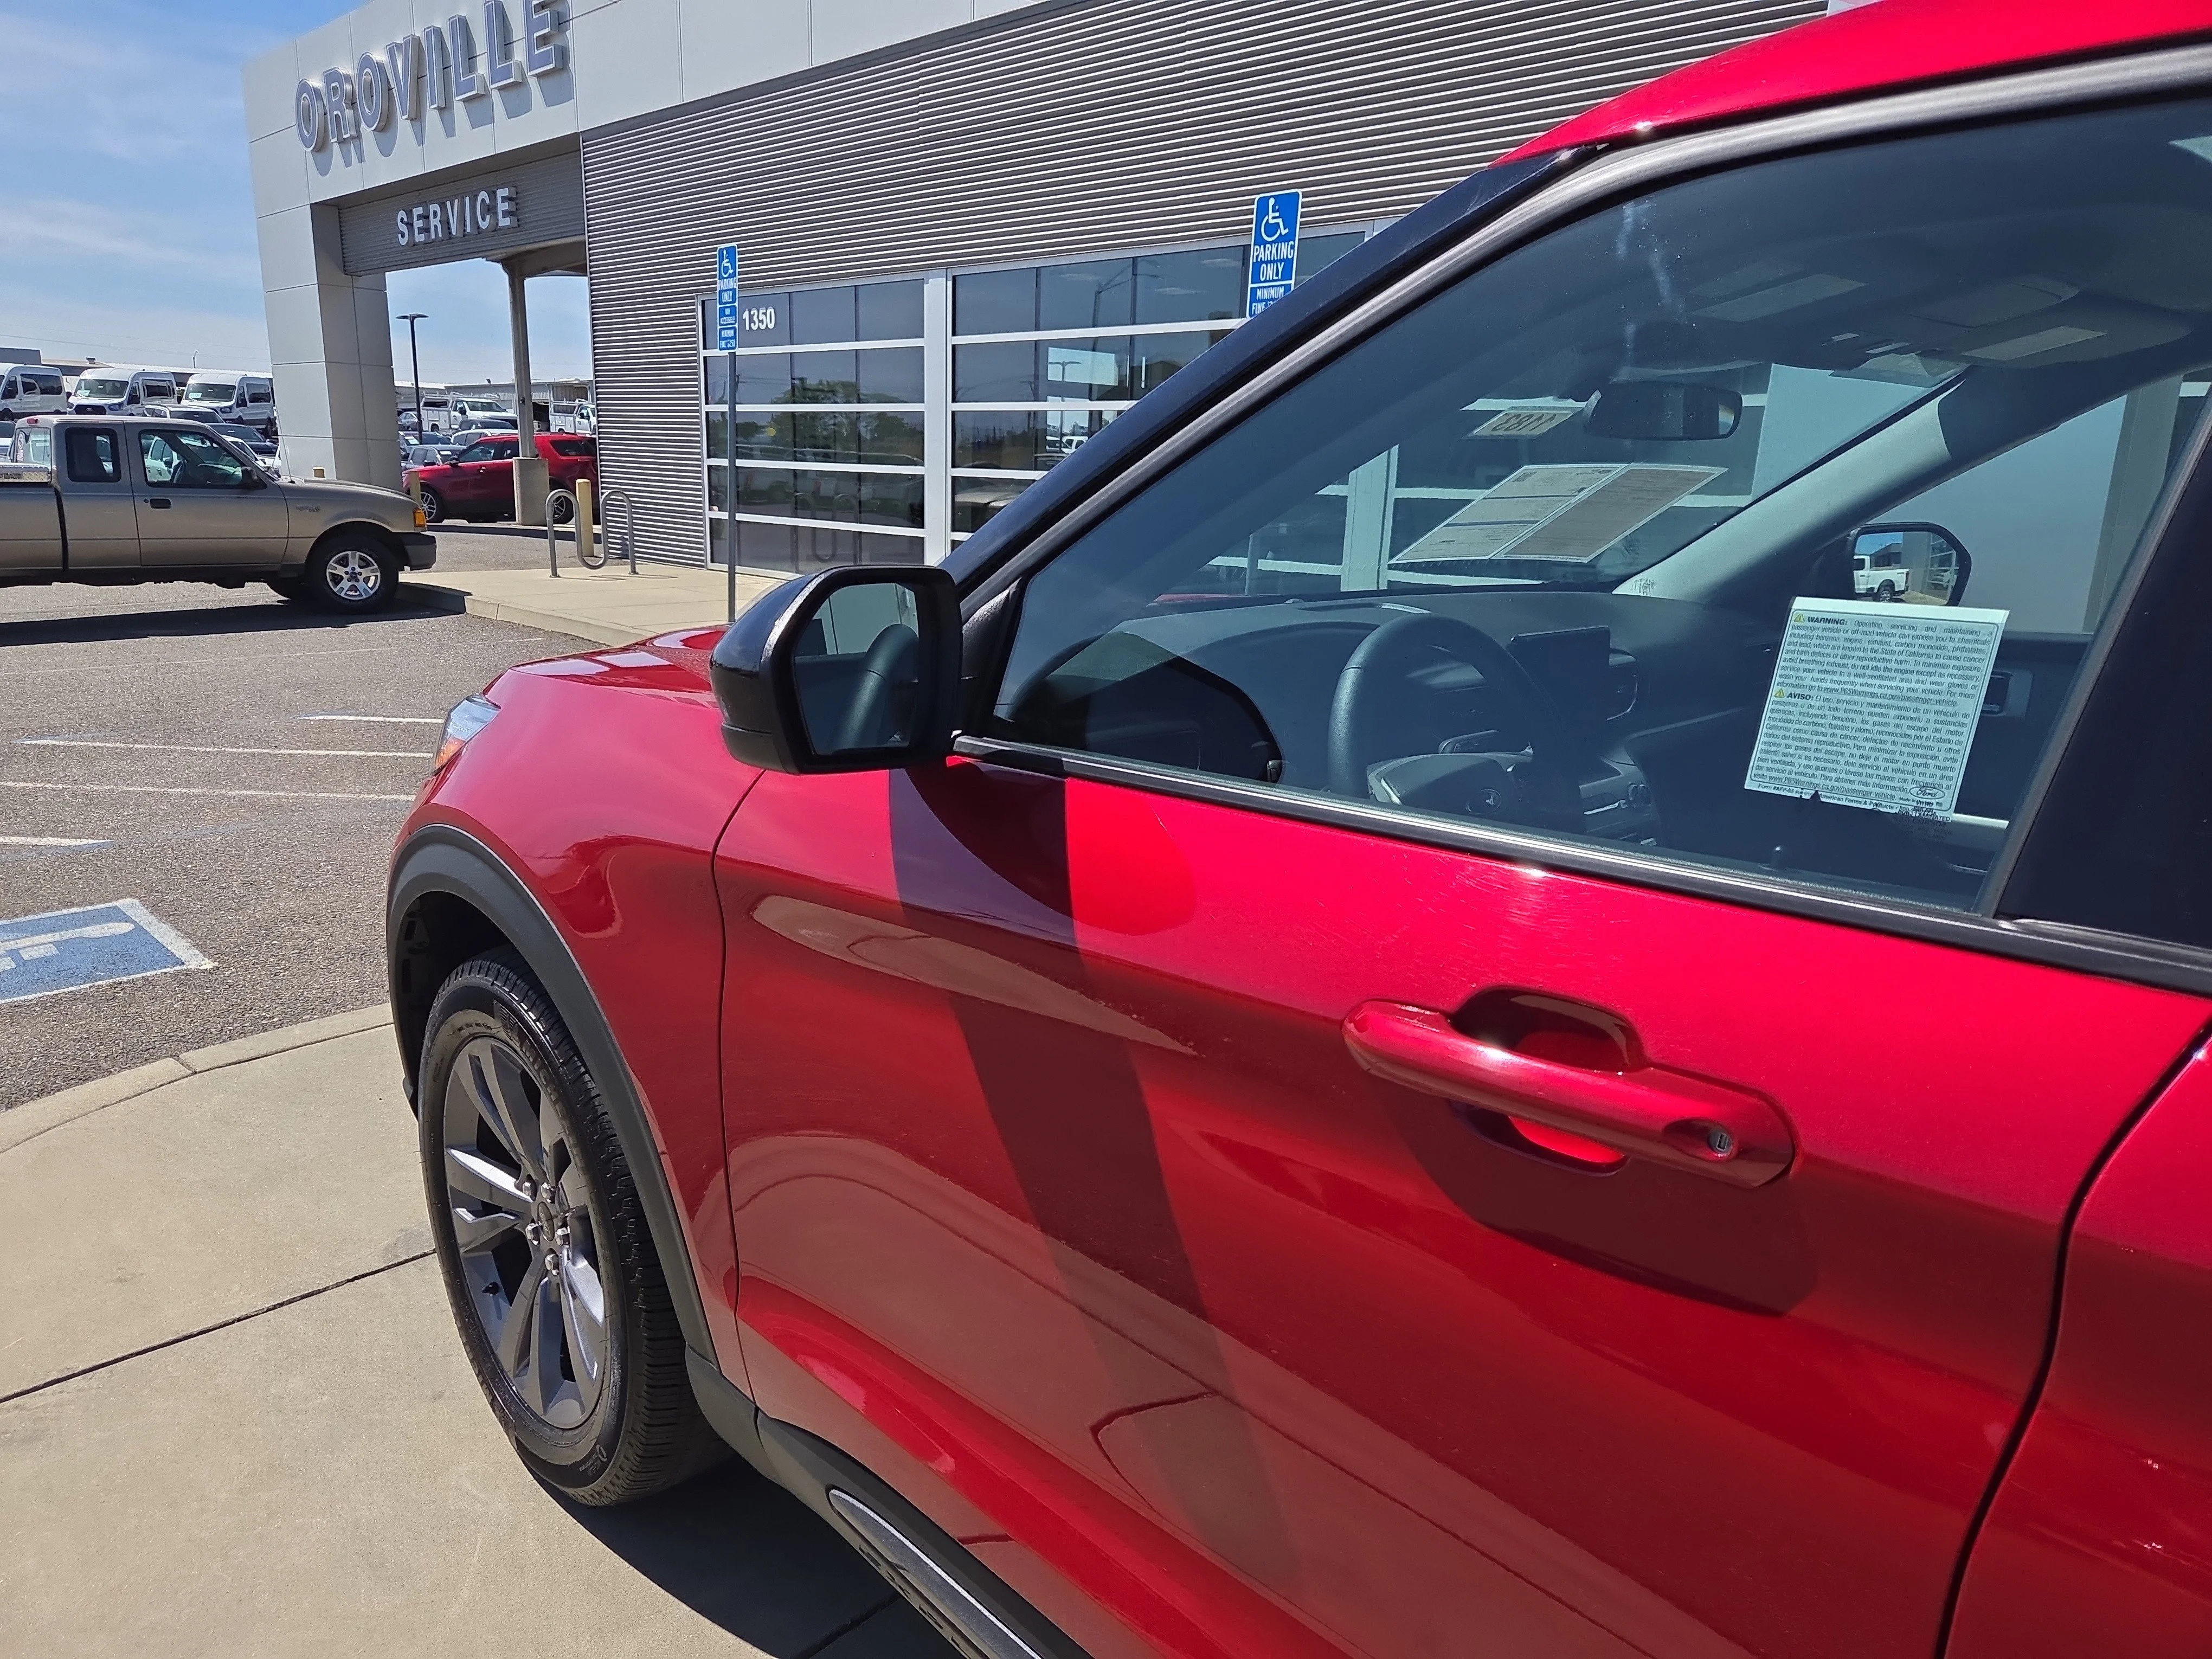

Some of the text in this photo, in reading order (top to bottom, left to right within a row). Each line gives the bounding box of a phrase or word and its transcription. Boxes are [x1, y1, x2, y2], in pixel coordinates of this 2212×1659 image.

[295, 0, 563, 152] OROVILLE
[397, 187, 511, 246] SERVICE
[1253, 241, 1294, 262] PARKING
[1260, 262, 1284, 281] ONLY
[719, 277, 737, 290] PARKING
[722, 290, 733, 303] ONLY
[1256, 286, 1284, 300] MINIMUM
[743, 306, 775, 331] 1350
[1808, 616, 1847, 625] WARNING:
[1787, 692, 1814, 700] AVISO:
[1916, 786, 1938, 797] Ford
